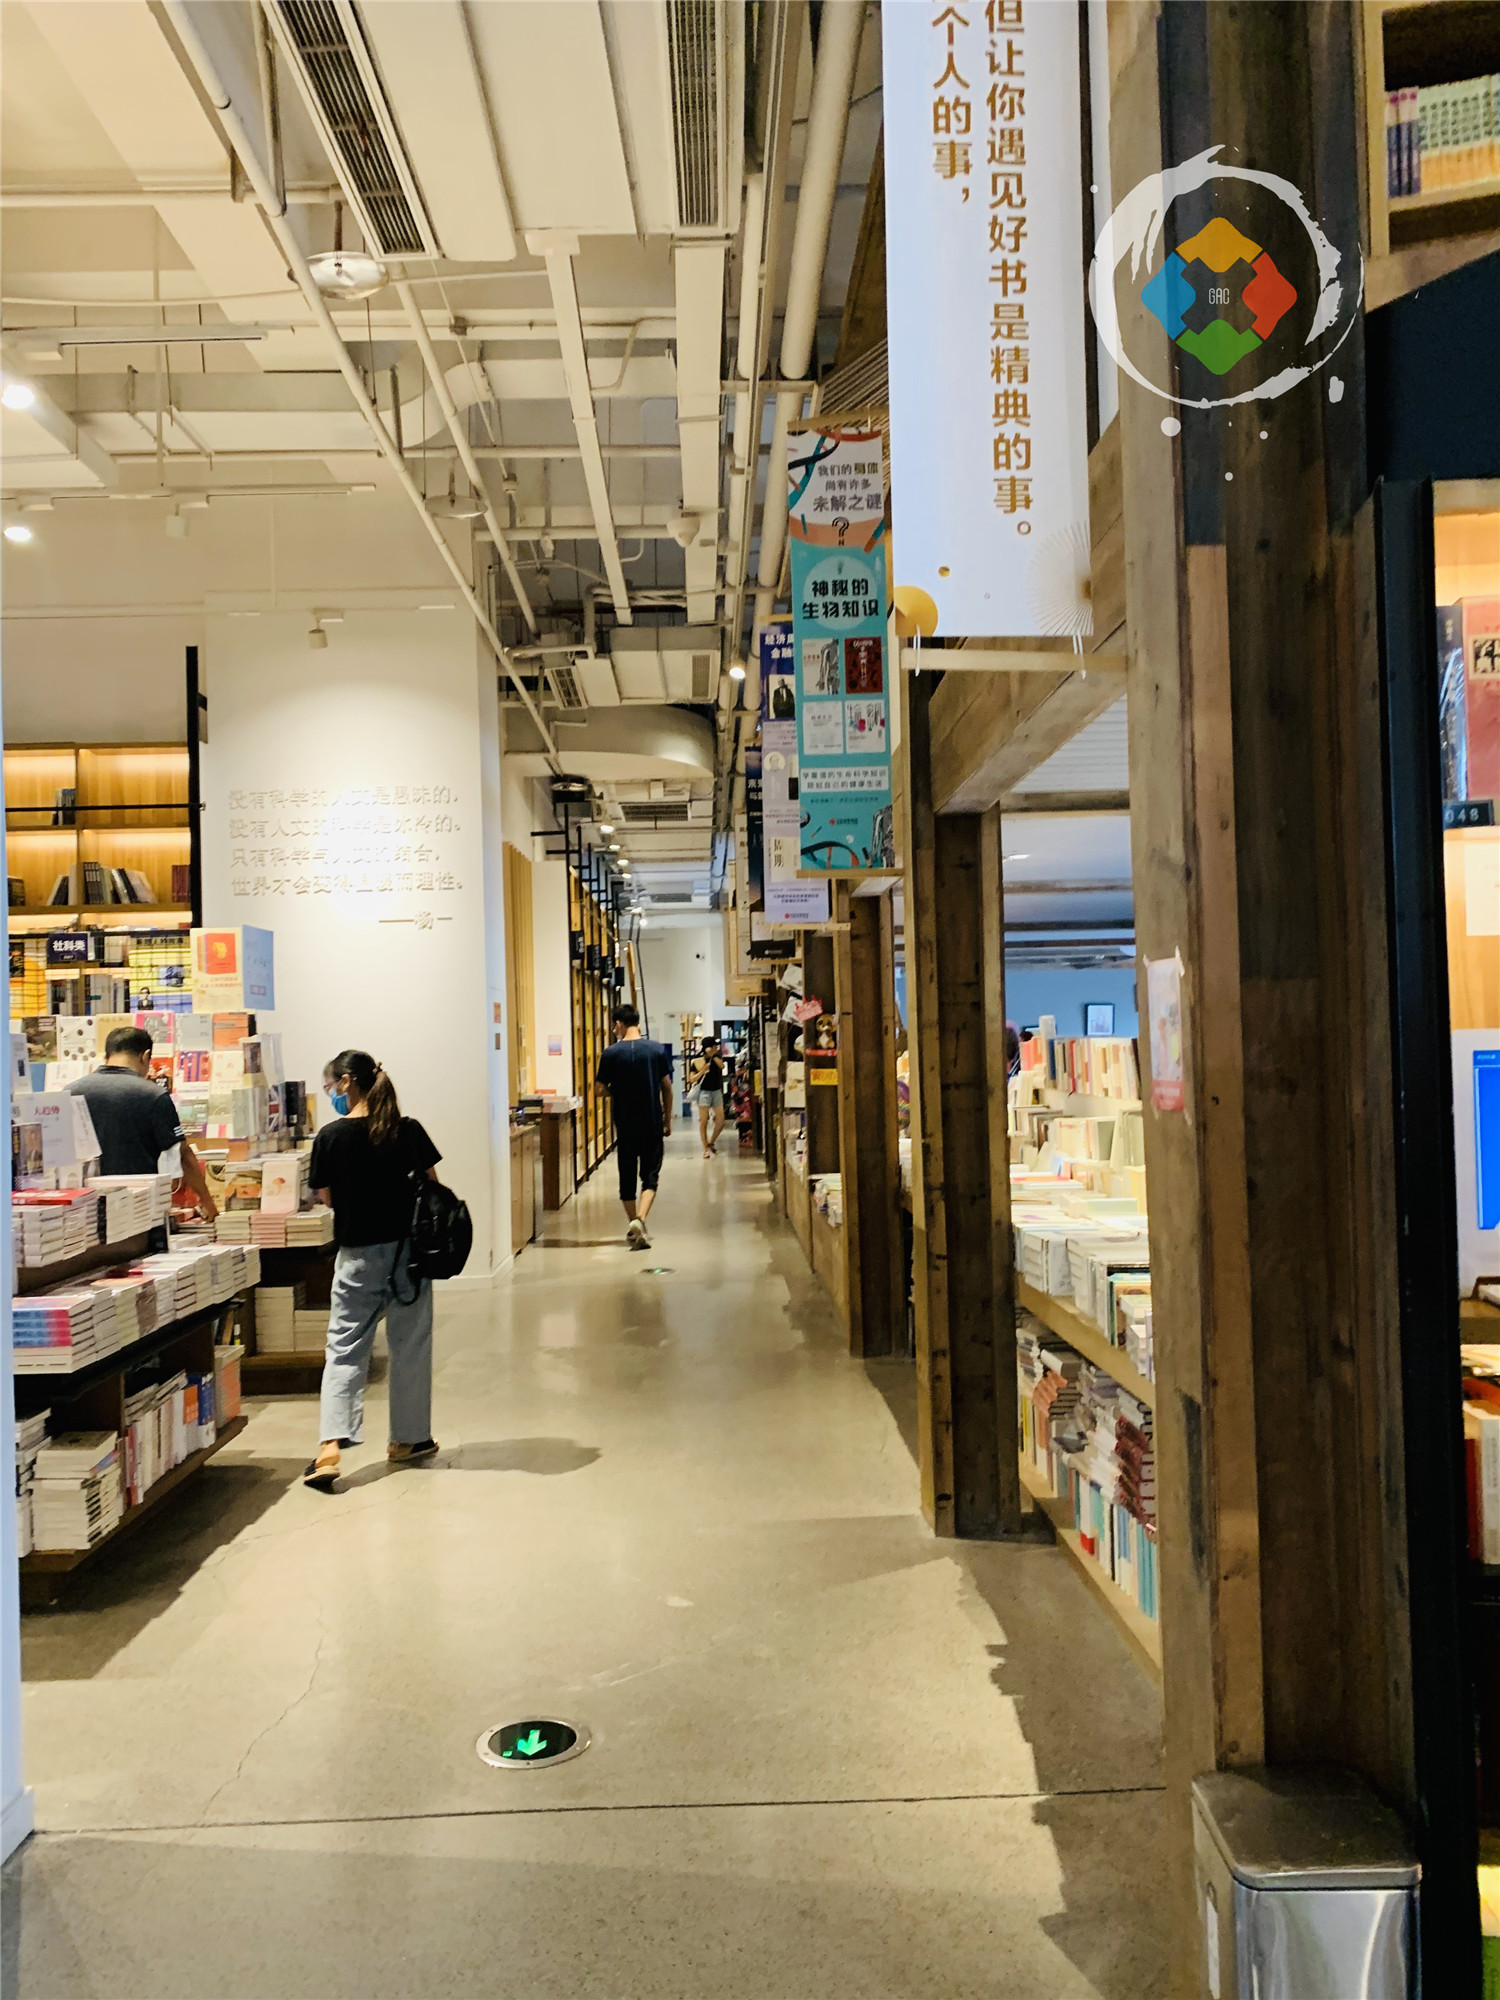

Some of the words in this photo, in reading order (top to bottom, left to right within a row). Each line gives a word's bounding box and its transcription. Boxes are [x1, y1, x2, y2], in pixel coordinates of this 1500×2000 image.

[932, 6, 973, 203] 个人的事，
[985, 0, 1033, 537] 但让你遇见好书是精典的事。
[813, 493, 882, 512] 未解之谜
[811, 578, 869, 598] 神秘的
[802, 599, 879, 620] 生物知识
[53, 939, 86, 951] 社科类
